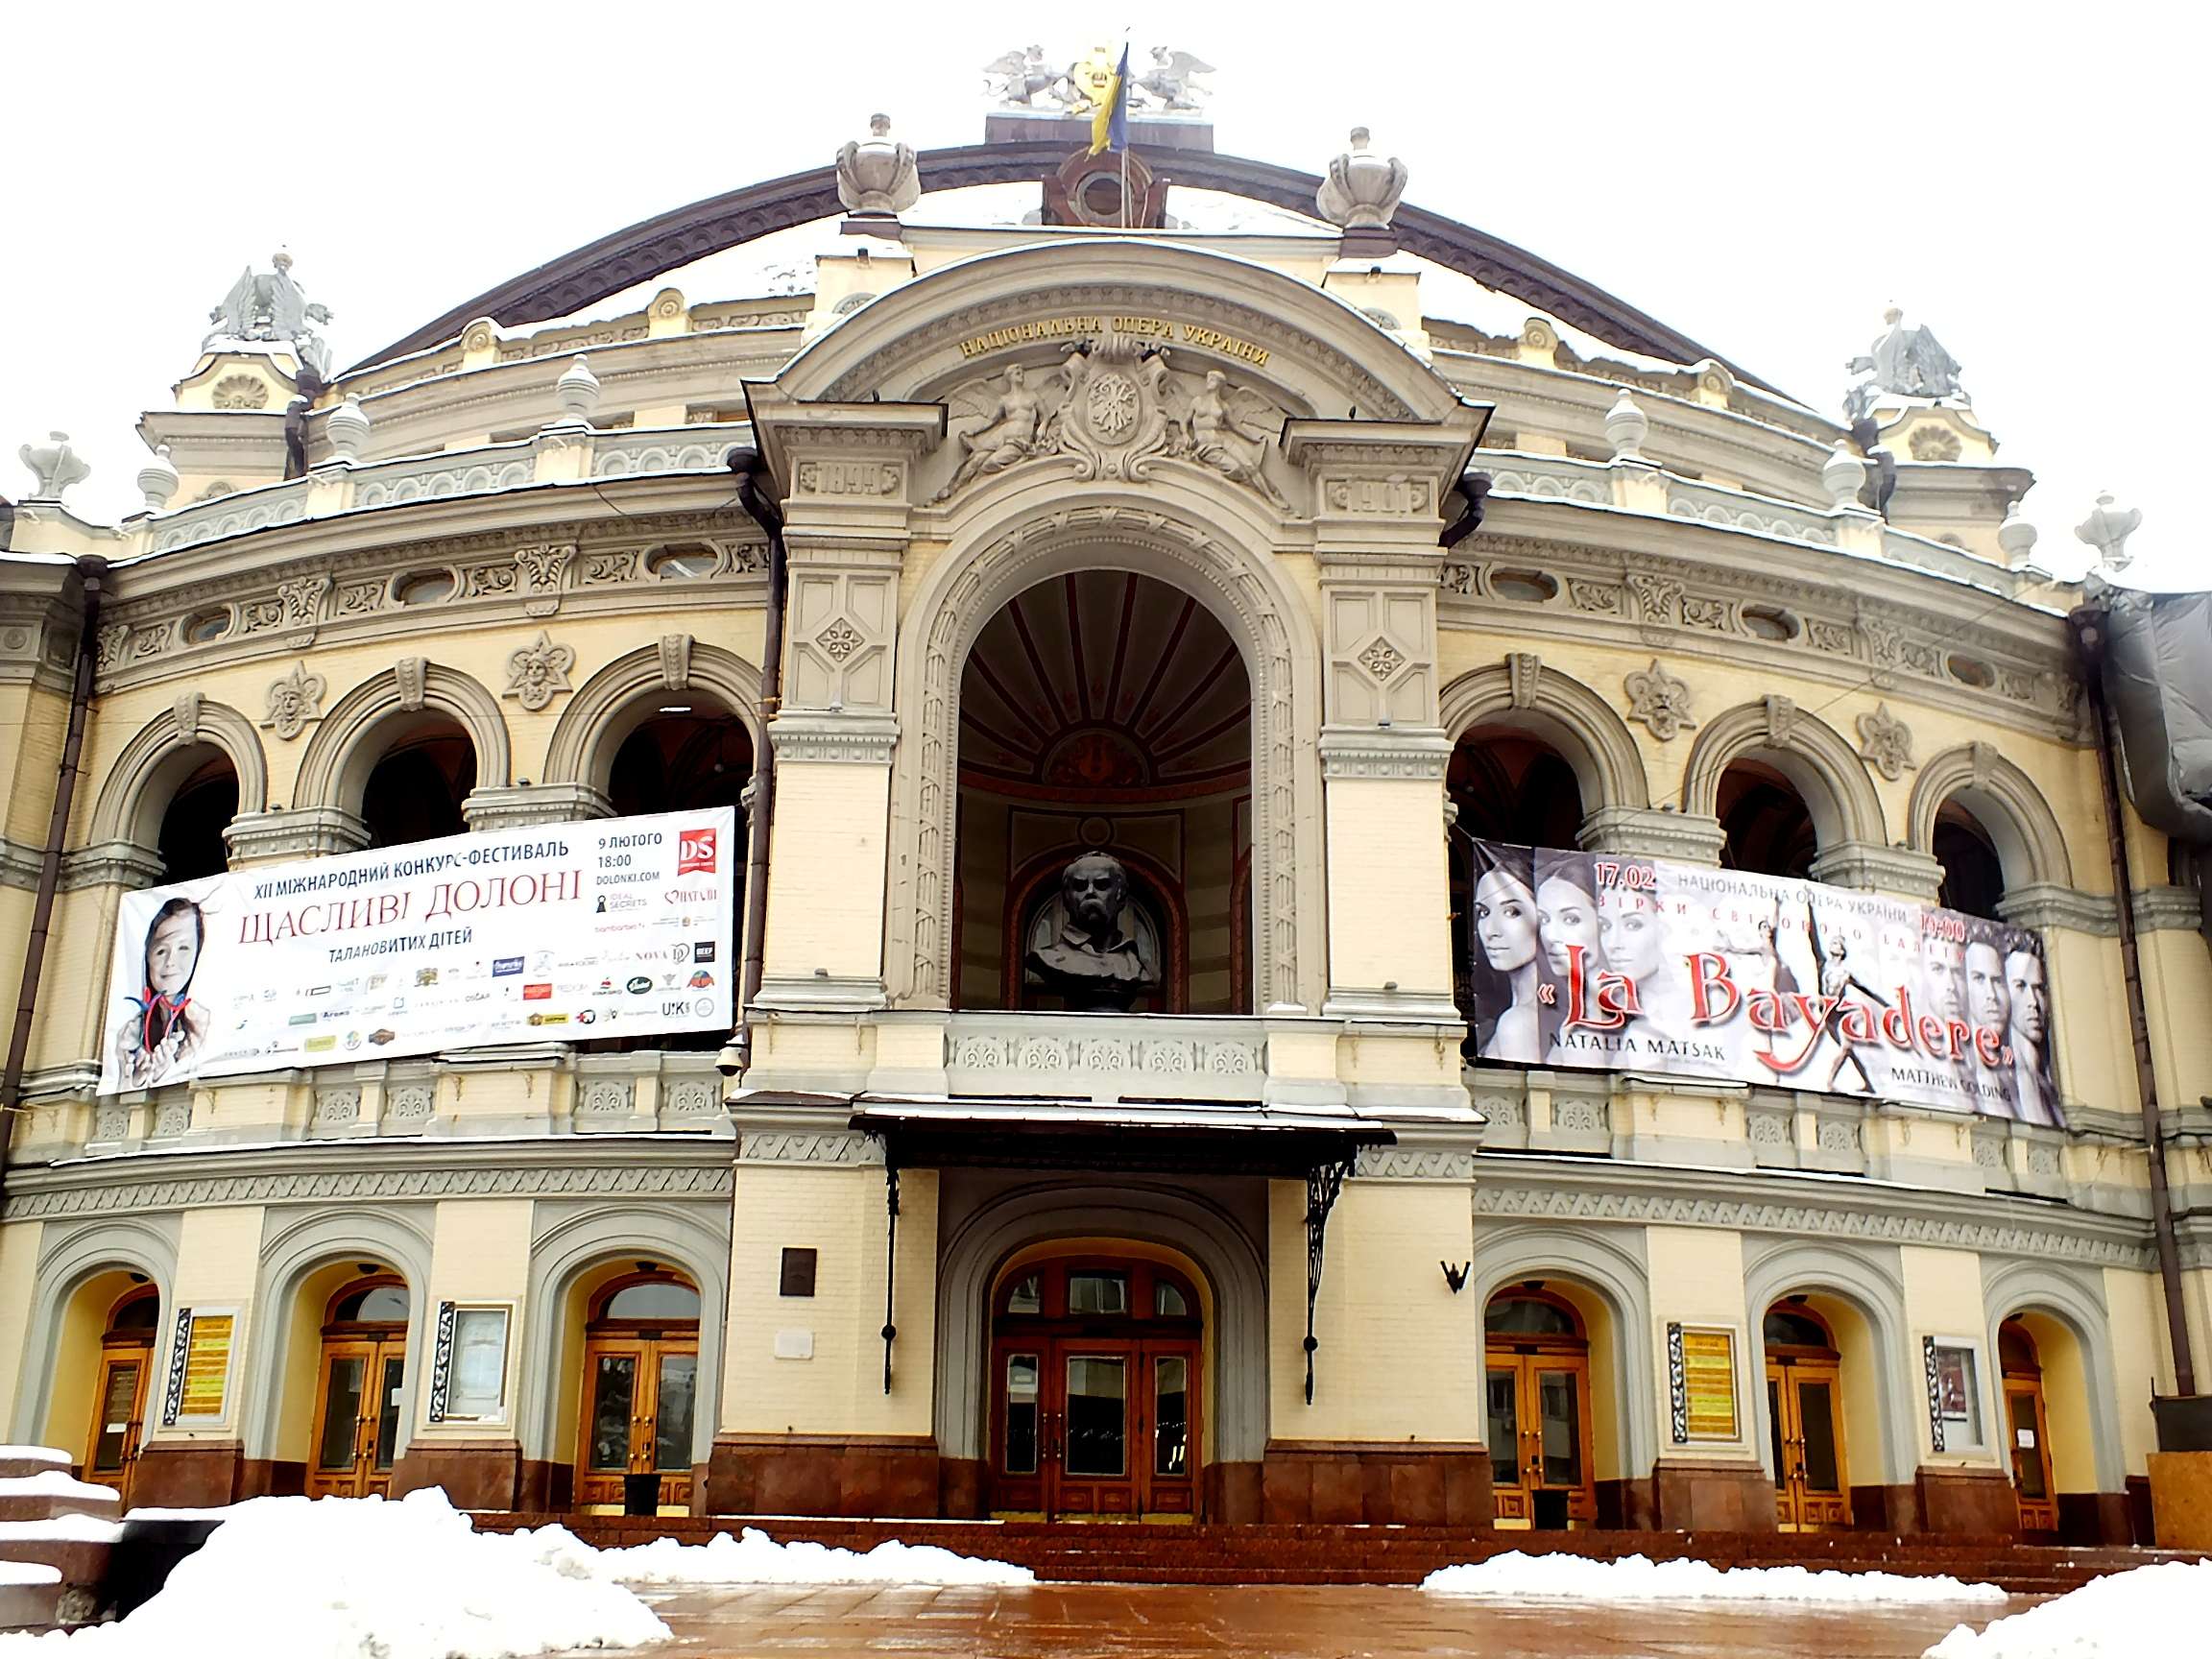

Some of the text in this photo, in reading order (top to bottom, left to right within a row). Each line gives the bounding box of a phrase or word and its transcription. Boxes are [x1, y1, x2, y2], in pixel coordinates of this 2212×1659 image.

[960, 316, 1102, 358] НАЦІОНАЛЬНА
[1112, 316, 1173, 339] ОПЕРА
[598, 832, 662, 850] 9 ЛЮТОГО
[680, 835, 714, 861] DS
[276, 862, 390, 897] МІЖНАРОДНИЙ
[394, 841, 569, 878] КОНКУРС-ФЕСТИВАЛЬ
[598, 854, 632, 868] 18:00
[596, 872, 661, 885] DOLONKI.COM
[1594, 861, 1656, 890] 17.02
[1678, 874, 1790, 902] НАЦІОНАЛЬНА
[238, 869, 584, 947] ЩАСЛИВІ ДОЛОНІ
[328, 927, 472, 964] ТАЛАНОВИТИХ ДІТЕЙ
[1550, 1032, 1725, 1061] NATALIA MATSAK
[1891, 1068, 1959, 1090] MATTHEW
